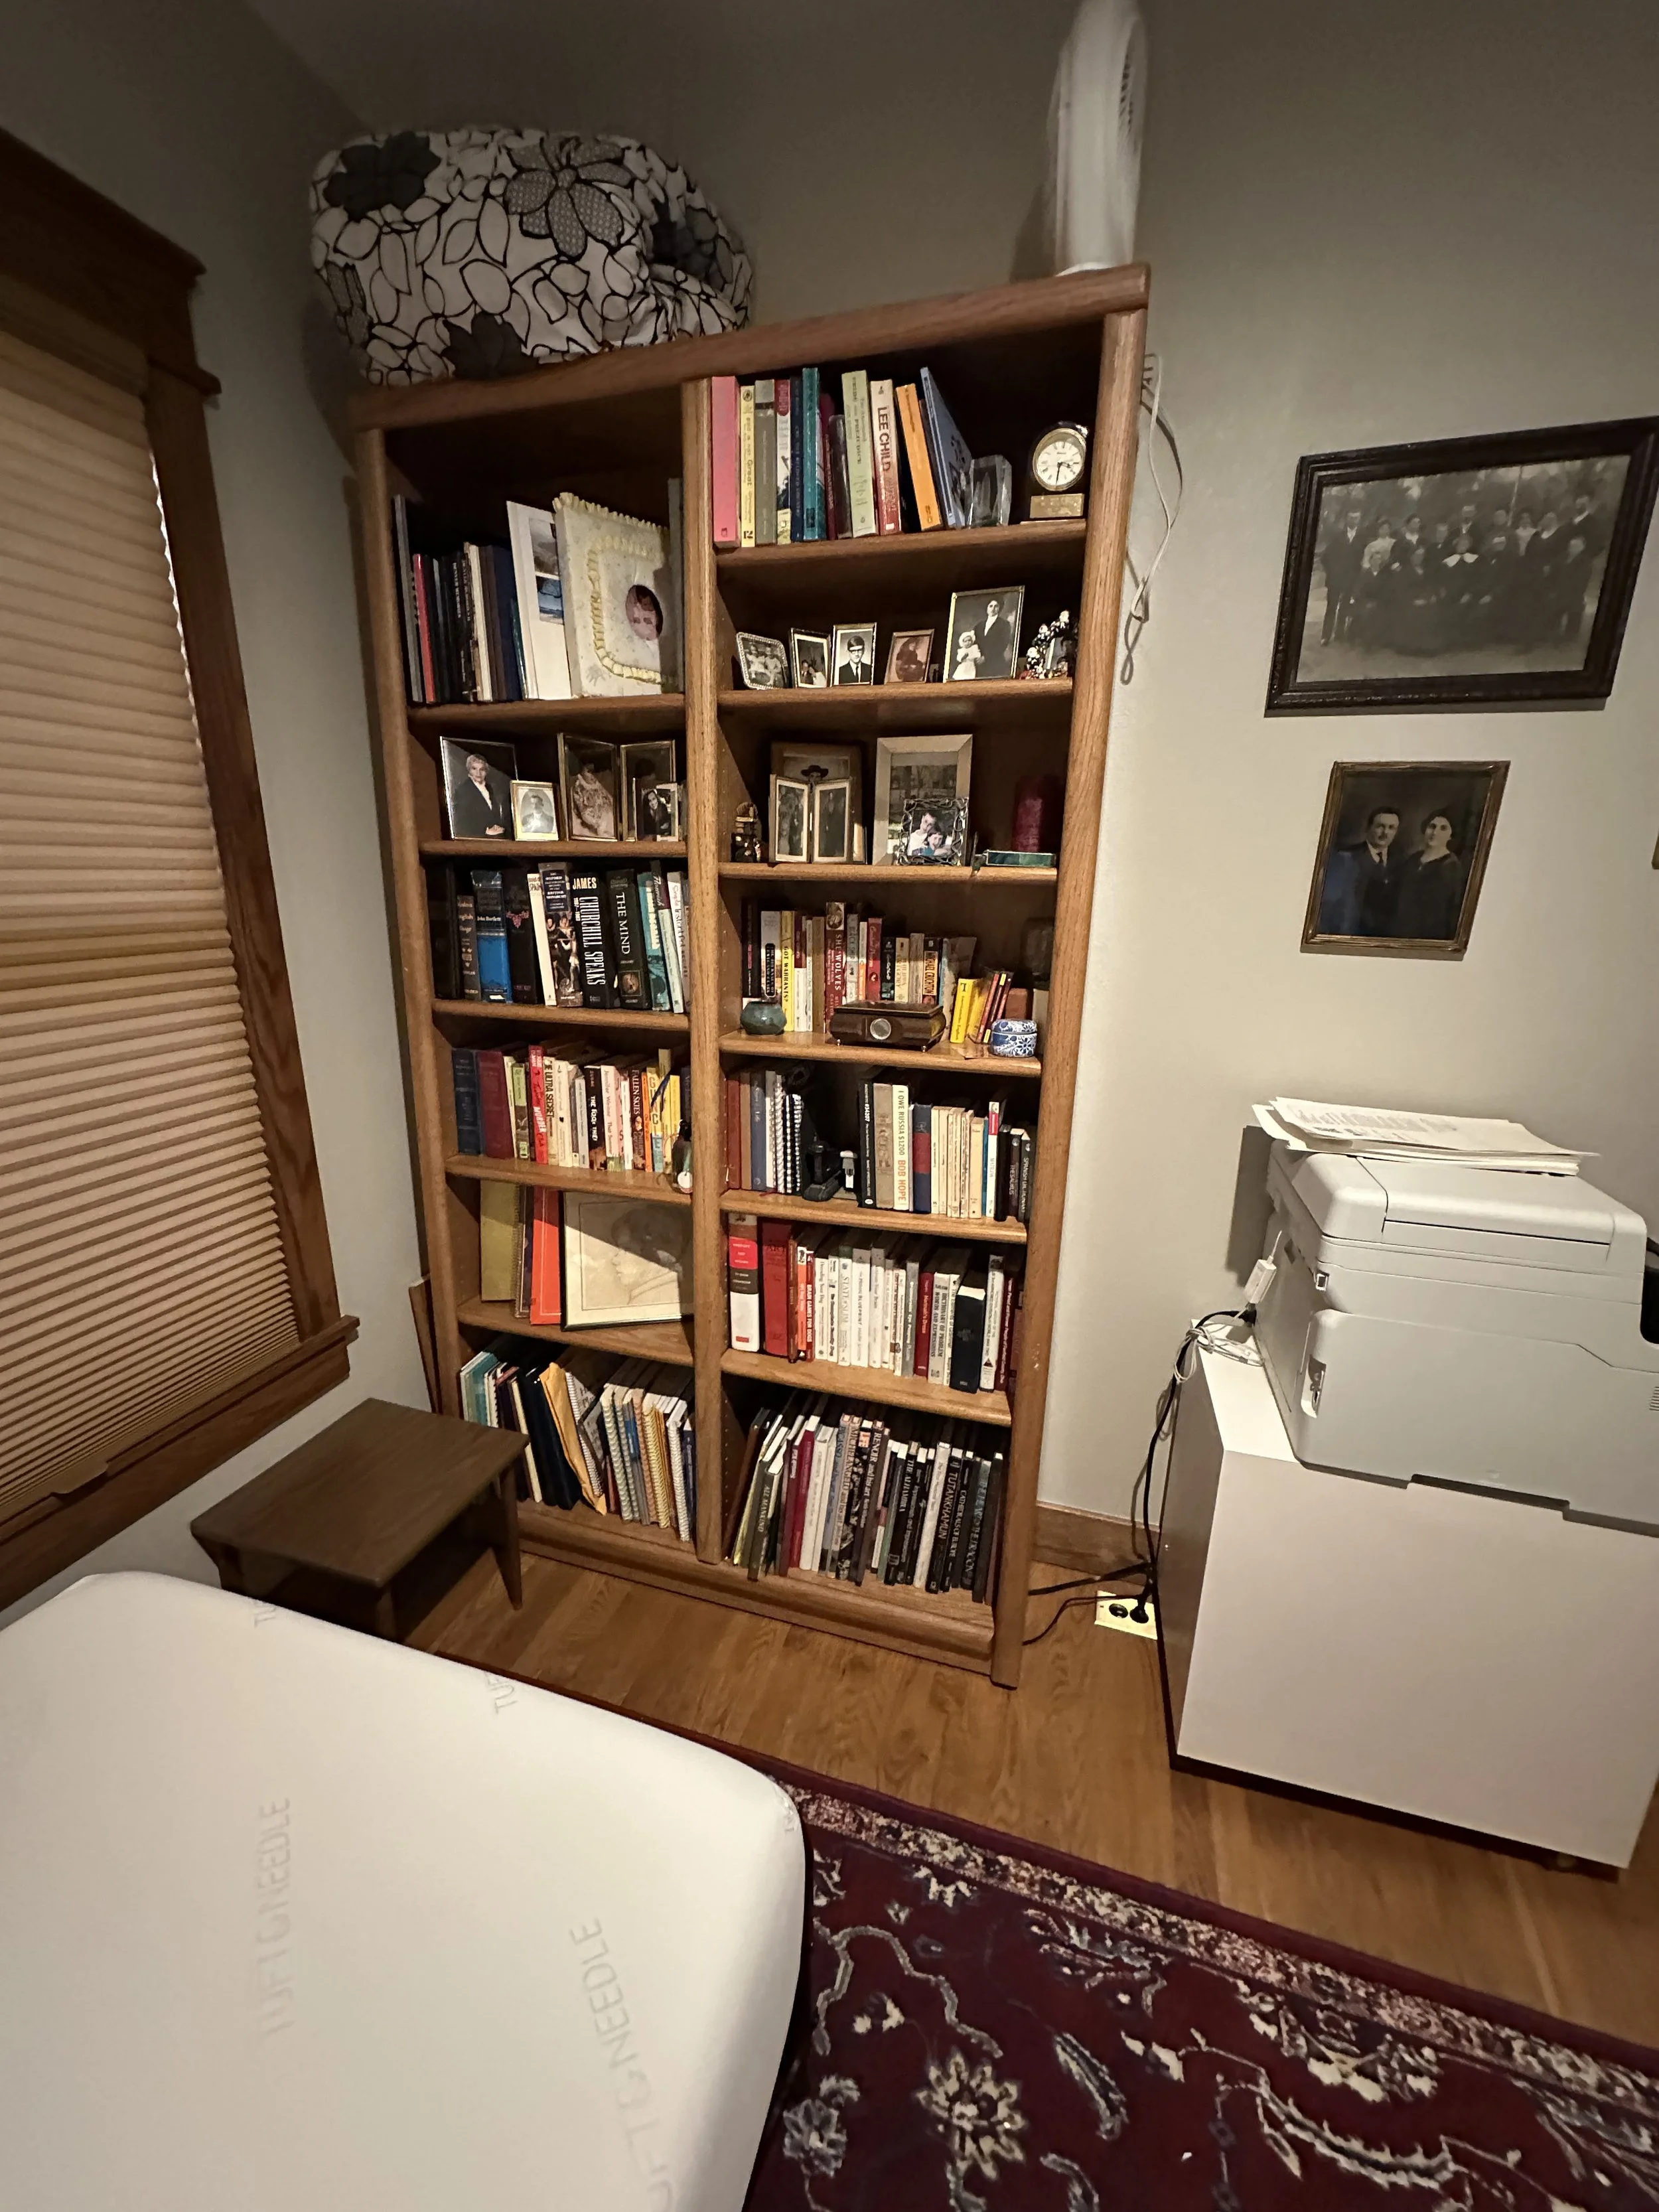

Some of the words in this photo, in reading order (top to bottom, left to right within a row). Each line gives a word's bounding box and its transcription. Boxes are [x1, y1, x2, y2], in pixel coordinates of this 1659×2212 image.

[877, 406, 889, 430] LEE
[879, 432, 891, 472] CHILD
[573, 877, 597, 889] JAMES
[616, 892, 626, 917] THE
[579, 896, 603, 948] CHURCHILL
[619, 920, 630, 954] MIND
[585, 951, 607, 985] SPEAKS
[924, 952, 936, 971] MICHAEL
[925, 972, 936, 995] CRICHTON
[545, 1071, 553, 1092] ULTRA
[631, 1069, 640, 1095] FALLEN
[534, 1106, 546, 1132] MURDER
[545, 1094, 555, 1118] SECRET
[898, 1179, 906, 1201] HOPE
[834, 1427, 847, 1458] PICASSO
[869, 1432, 882, 1462] RENOIR
[842, 1428, 859, 1491] MICHELANGELO
[906, 1459, 914, 1473] THE
[762, 1485, 771, 1496] ALL
[757, 1498, 768, 1532] MANKIND
[938, 1471, 958, 1540] TUTANKHAMUN
[954, 1489, 967, 1528] CATHEDRALS
[952, 1528, 960, 1536] OF
[949, 1536, 959, 1557] EUROPE
[964, 1540, 979, 1572] DRAGON
